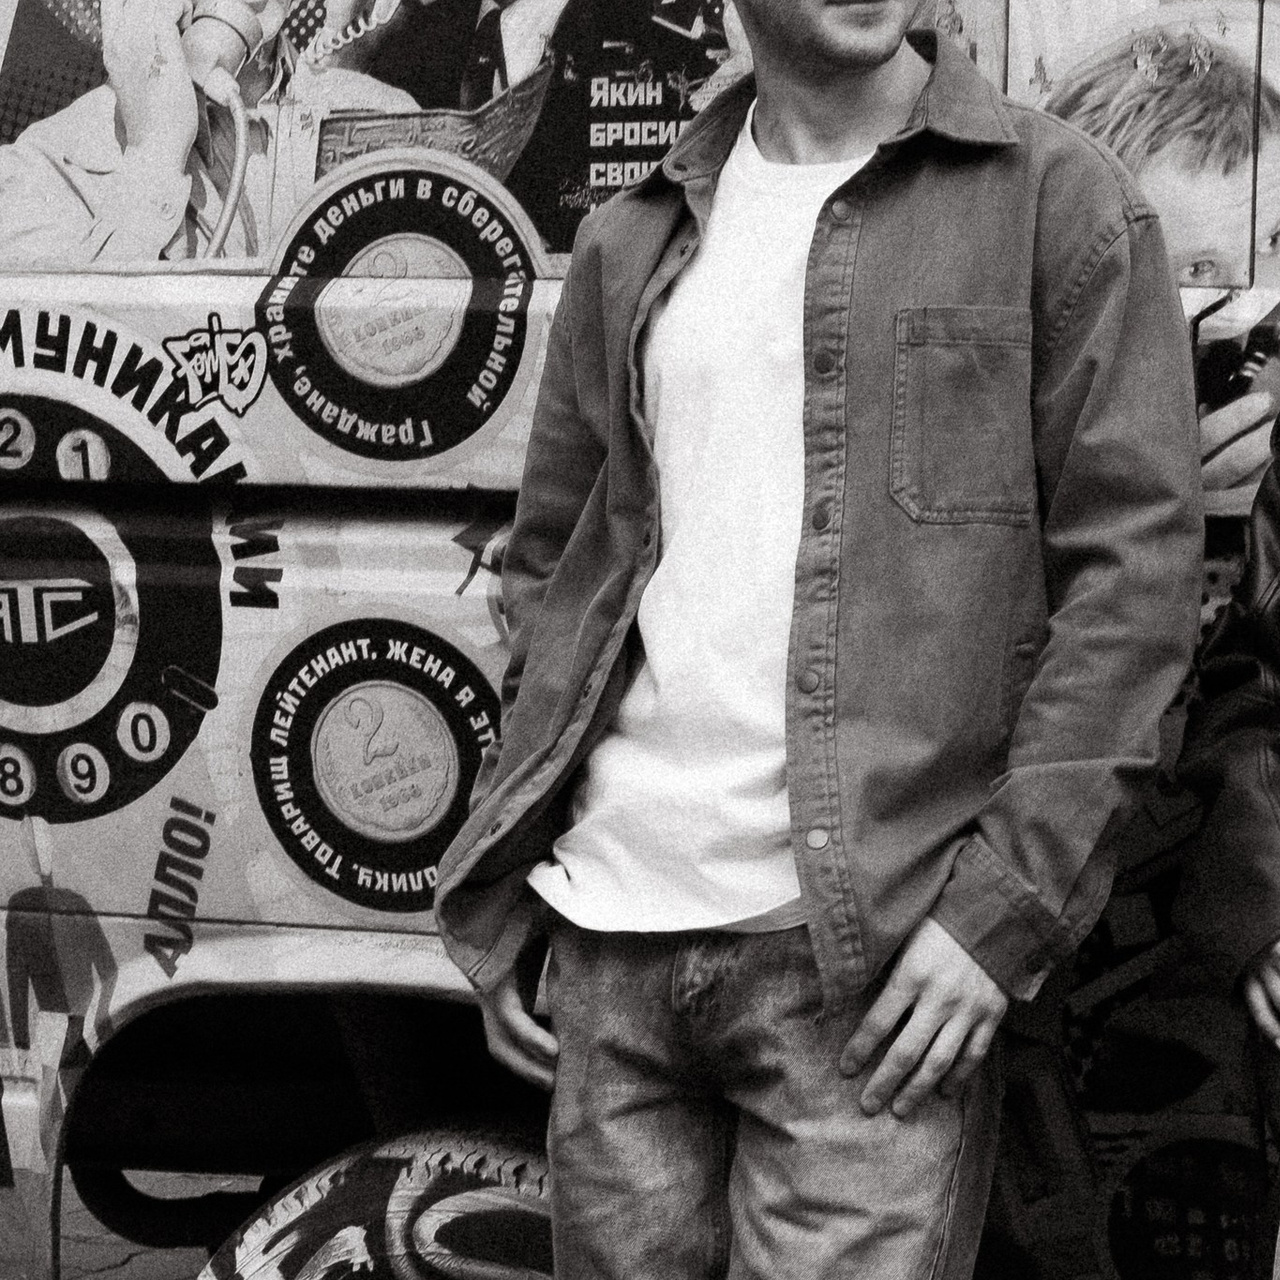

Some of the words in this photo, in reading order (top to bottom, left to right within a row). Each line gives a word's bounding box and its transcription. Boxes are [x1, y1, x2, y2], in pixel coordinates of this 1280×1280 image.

[0, 417, 22, 458] 2
[71, 438, 91, 480] 1
[130, 712, 157, 754] 0
[0, 757, 24, 798] 8
[70, 753, 98, 795] 9
[143, 796, 217, 980] АЛЛО!
